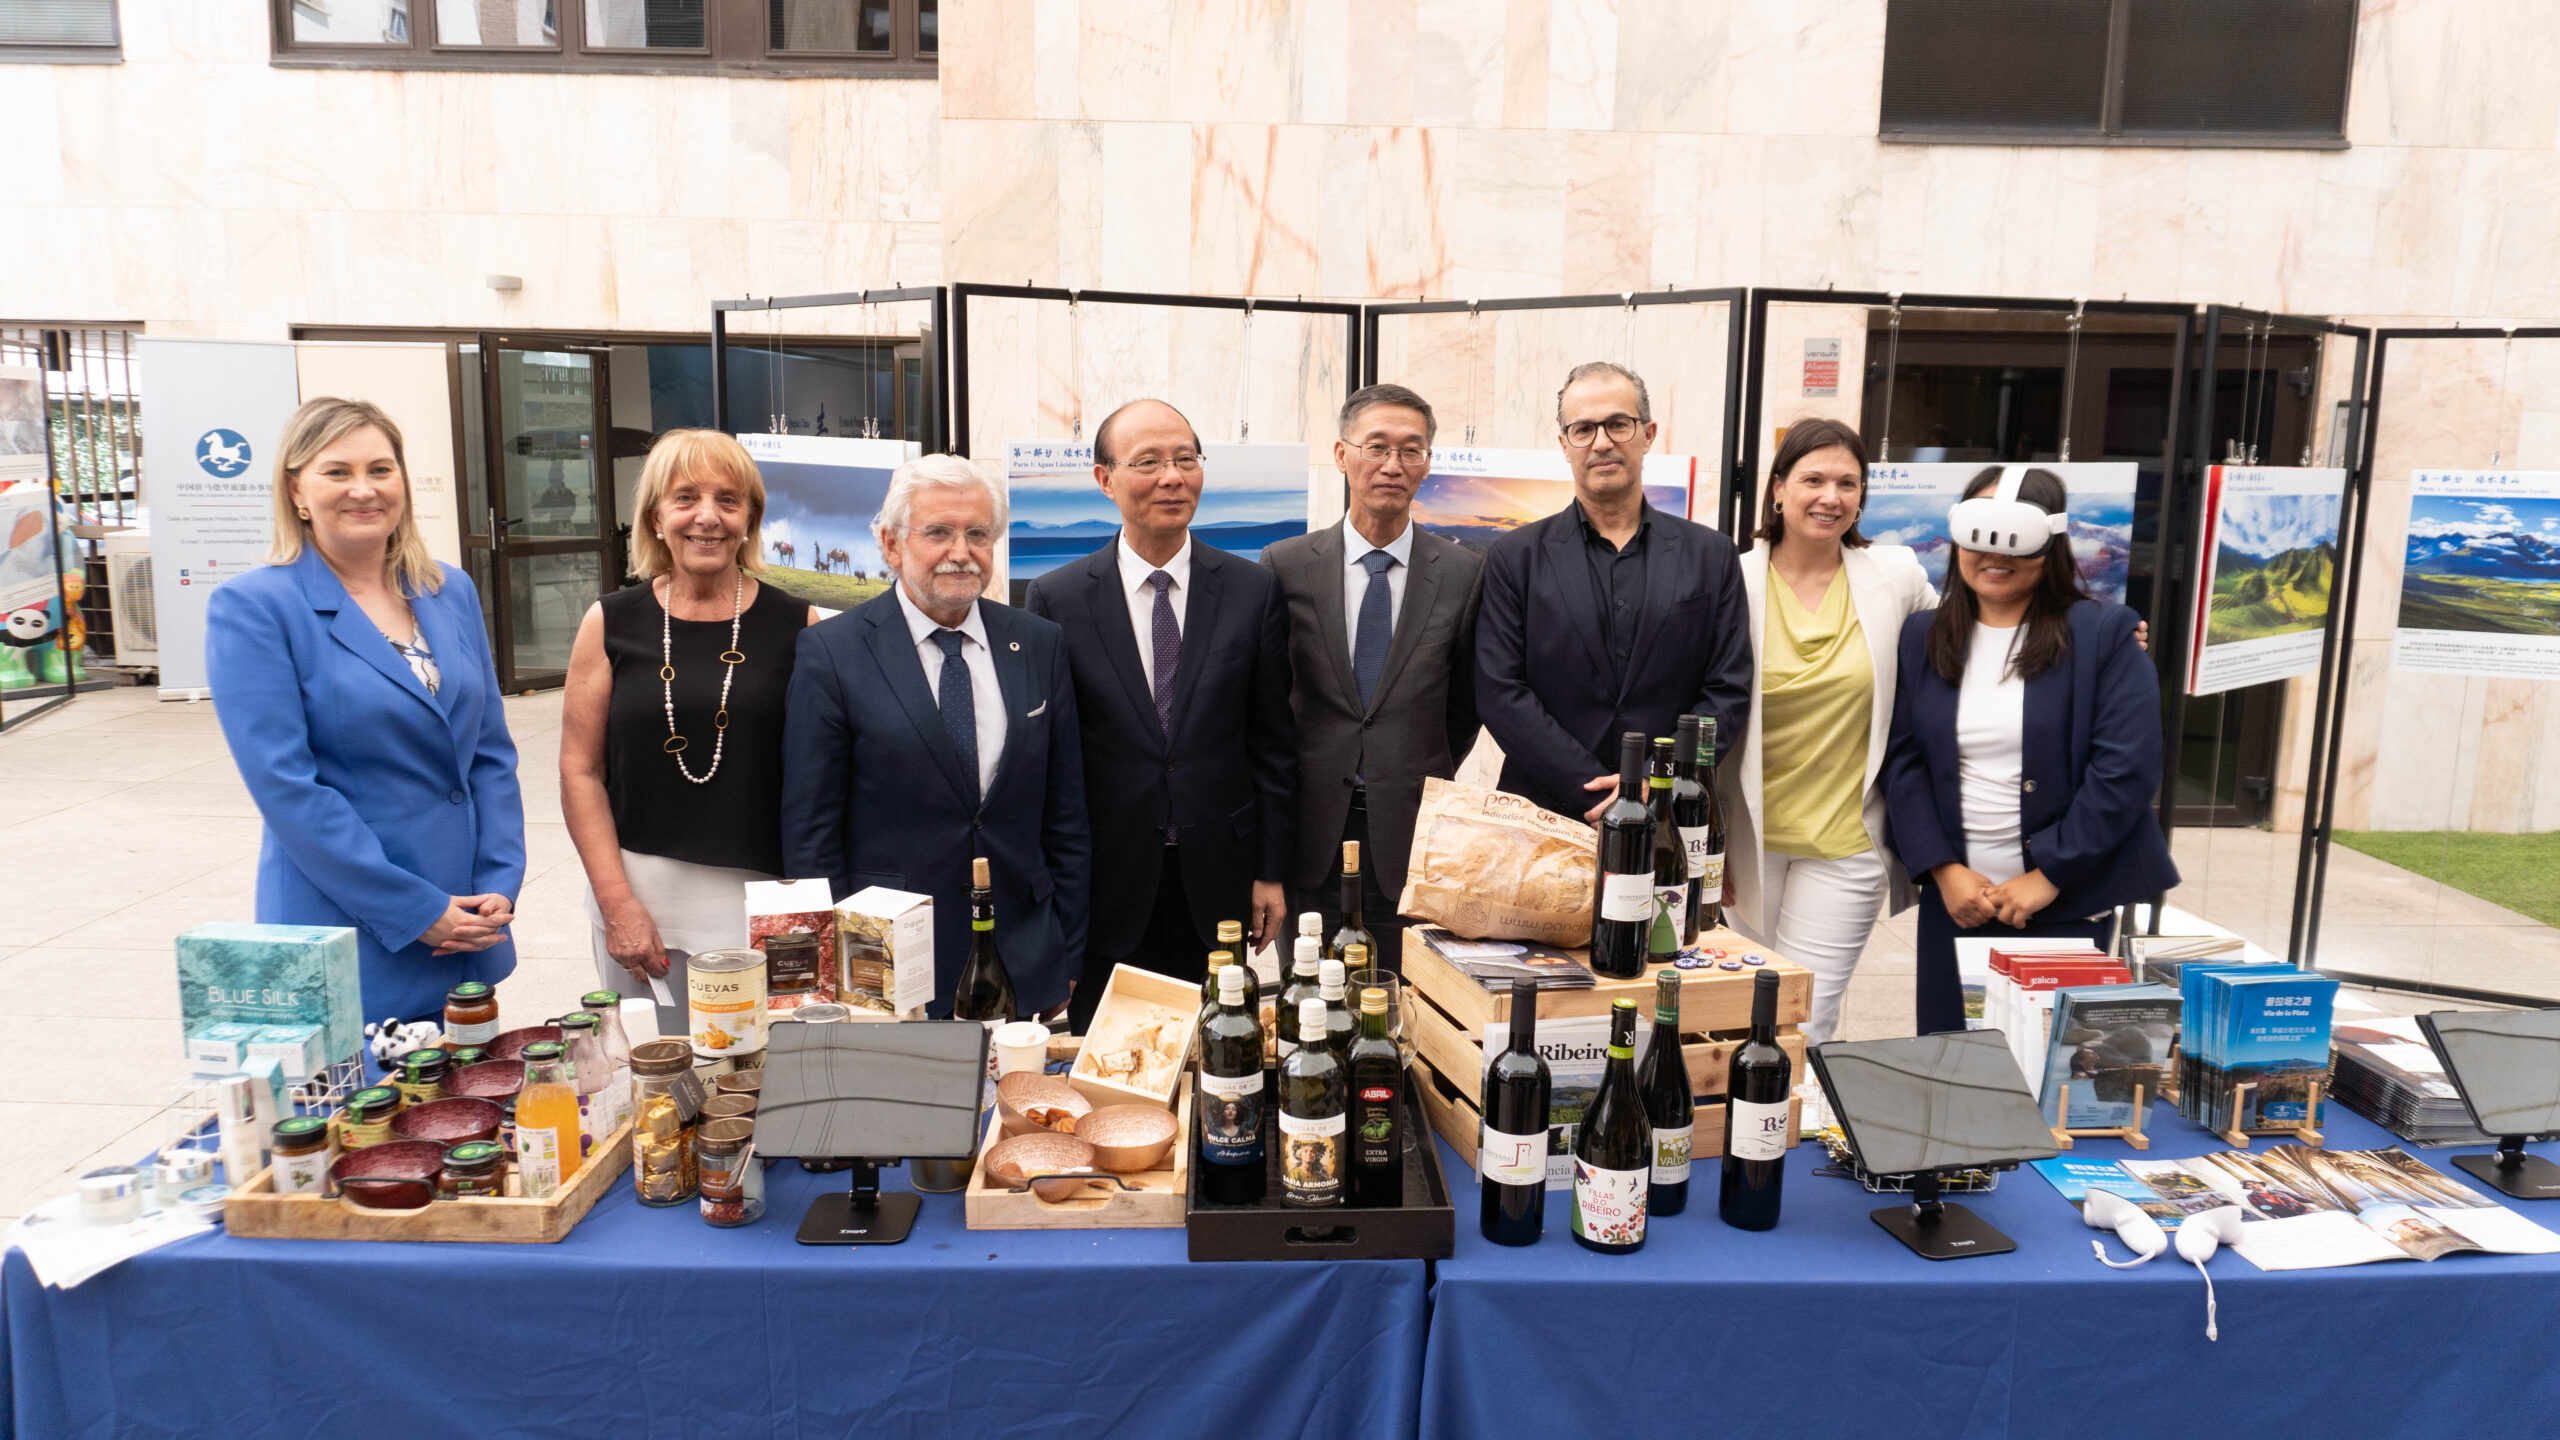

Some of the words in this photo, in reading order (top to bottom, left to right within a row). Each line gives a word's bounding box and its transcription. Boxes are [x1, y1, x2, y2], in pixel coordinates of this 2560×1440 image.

[1037, 461, 1054, 470] Aguas
[1483, 793, 1522, 808] pan
[1482, 808, 1525, 821] indicación
[1499, 915, 1591, 933] www.pande
[690, 979, 739, 992] CUEVAS
[2031, 976, 2059, 985] galicia
[208, 985, 258, 1005] BLUE
[261, 988, 300, 1007] SILK
[738, 1061, 765, 1069] UEV
[701, 1074, 721, 1086] VAS
[1364, 1089, 1390, 1099] ABRIL
[1207, 1133, 1229, 1144] DULCE
[1231, 1134, 1256, 1144] CALMA
[1659, 1152, 1691, 1166] VALDEO
[1547, 1164, 1571, 1176] ncia
[1303, 1177, 1339, 1188] ARMONÍA
[1588, 1188, 1615, 1200] FILLAS
[1593, 1197, 1609, 1207] D.O.
[1582, 1200, 1622, 1217] RIBEIRO
